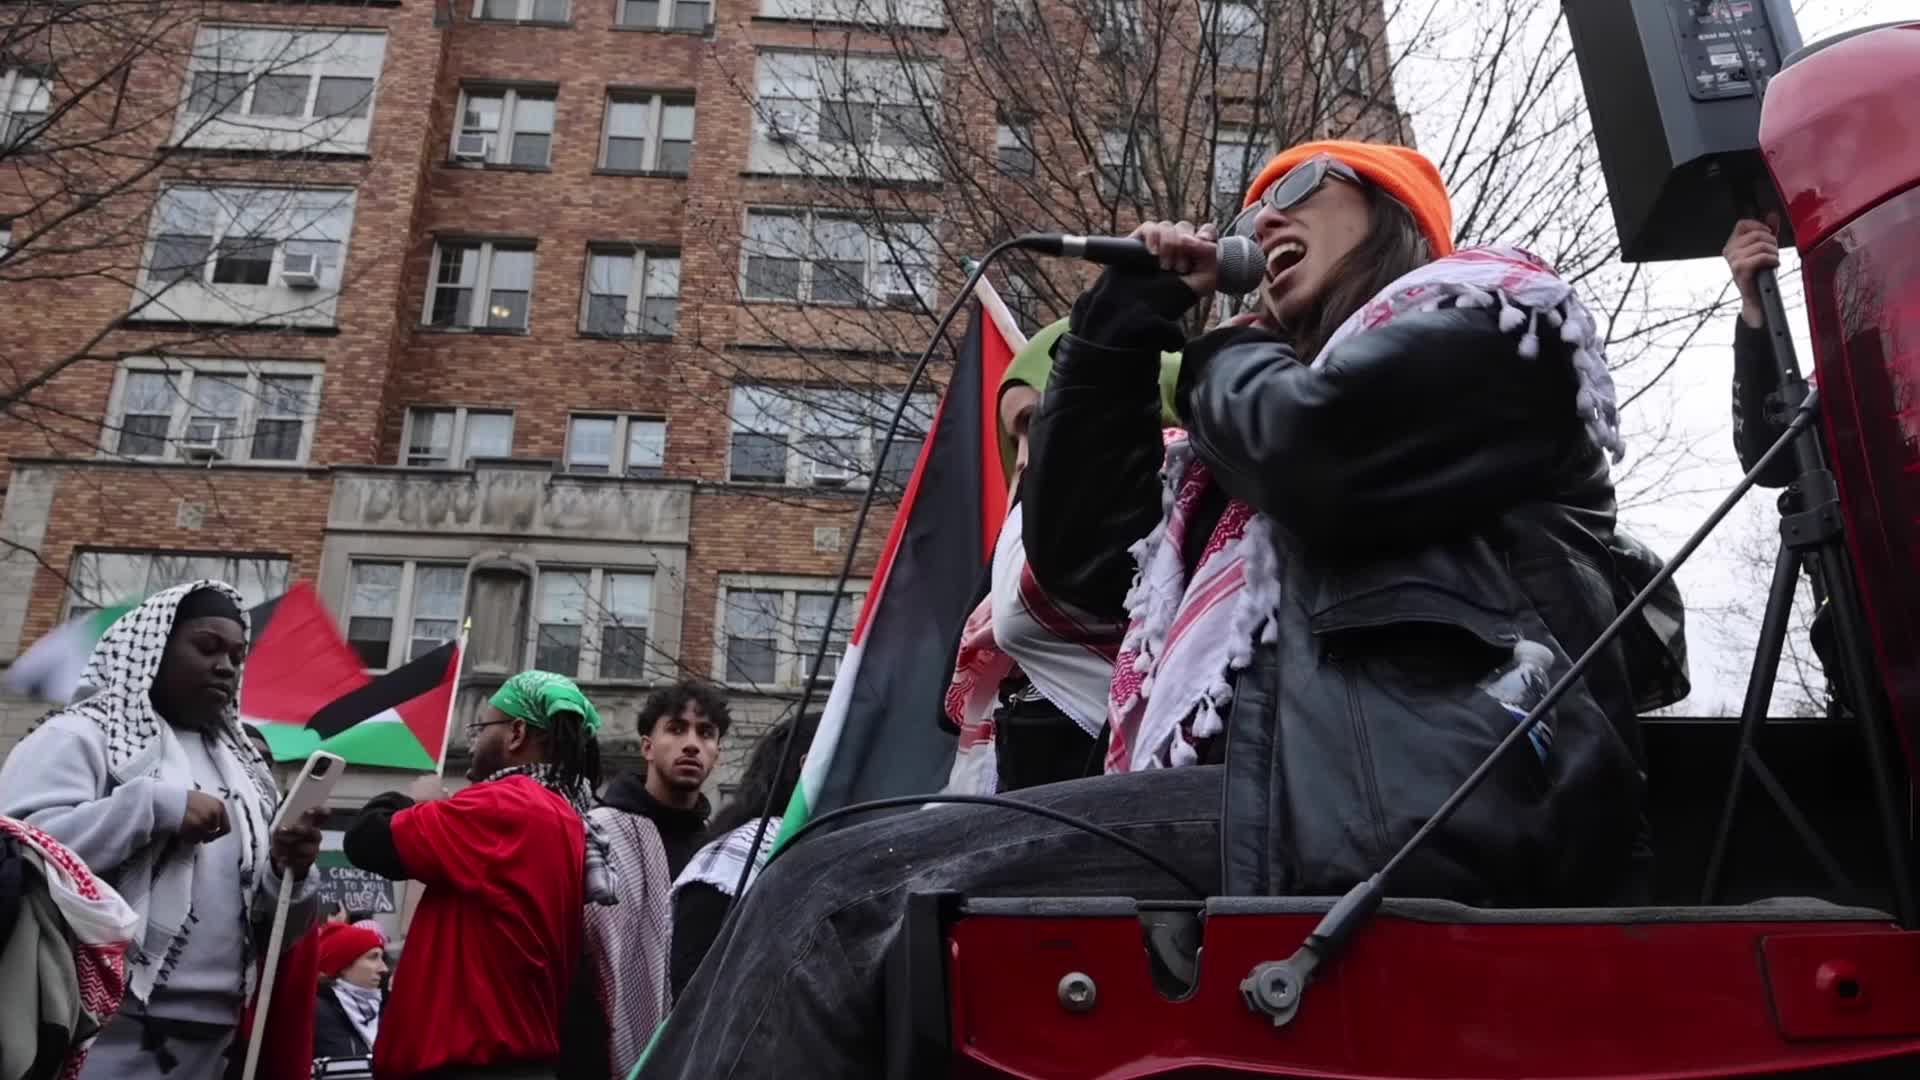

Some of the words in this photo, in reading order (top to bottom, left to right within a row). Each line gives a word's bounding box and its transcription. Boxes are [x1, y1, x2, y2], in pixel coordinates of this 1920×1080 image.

[344, 880, 358, 890] TO
[361, 880, 384, 891] YOU
[344, 890, 393, 912] USA
